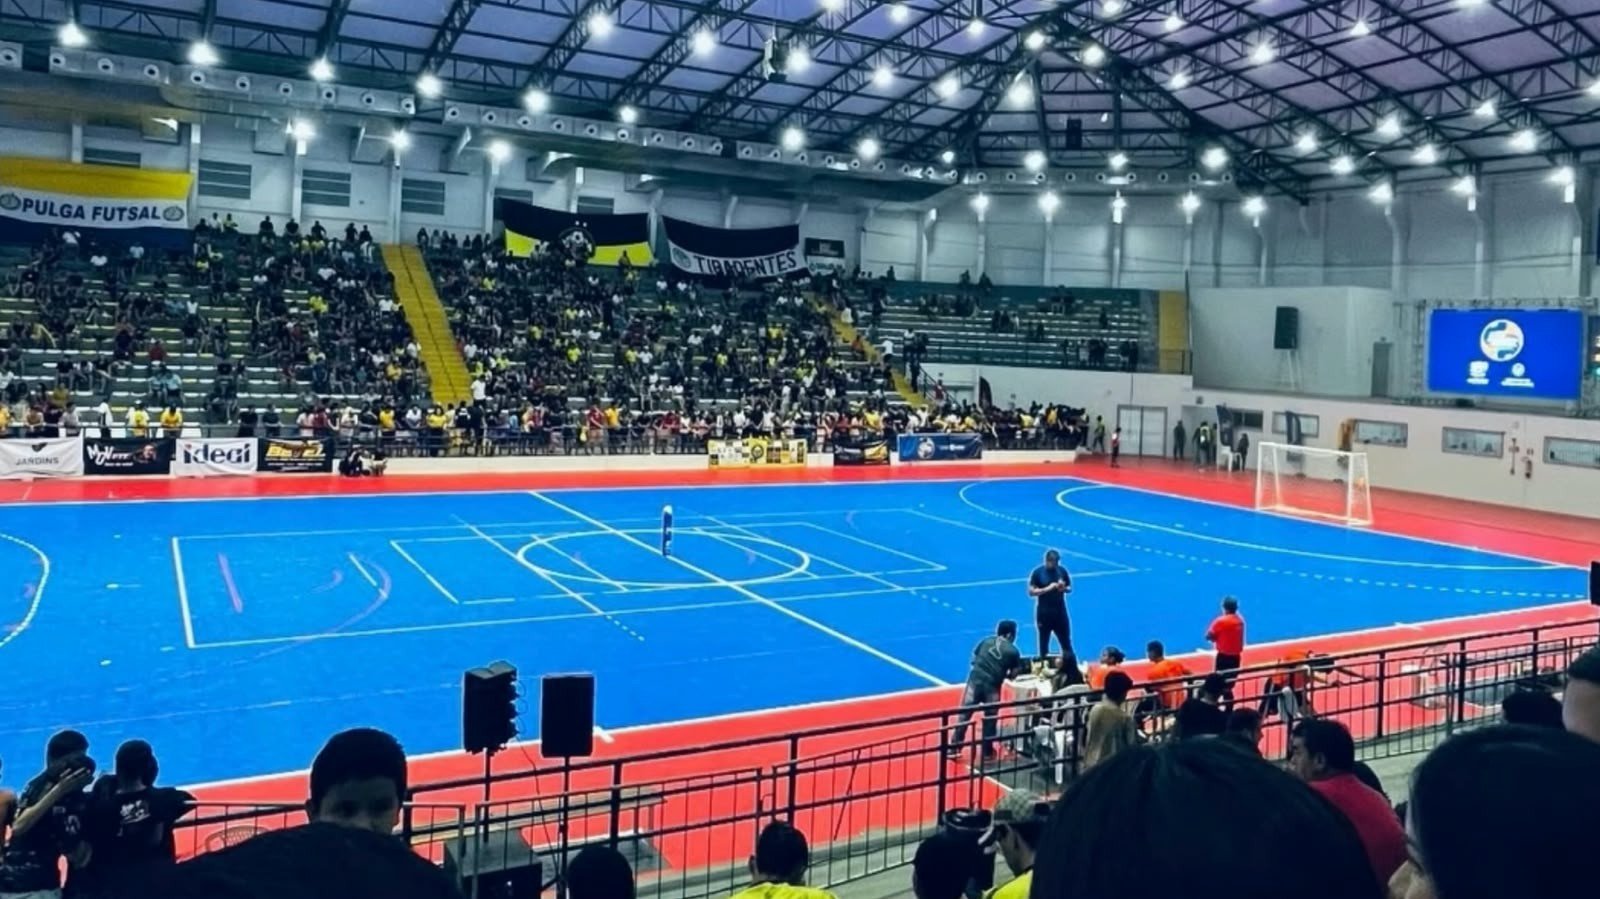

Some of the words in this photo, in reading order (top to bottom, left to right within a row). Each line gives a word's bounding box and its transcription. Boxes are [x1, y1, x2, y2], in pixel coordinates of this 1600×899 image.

[22, 197, 85, 220] PULGA
[91, 205, 161, 222] FUTSAL
[15, 456, 60, 466] JARDINS
